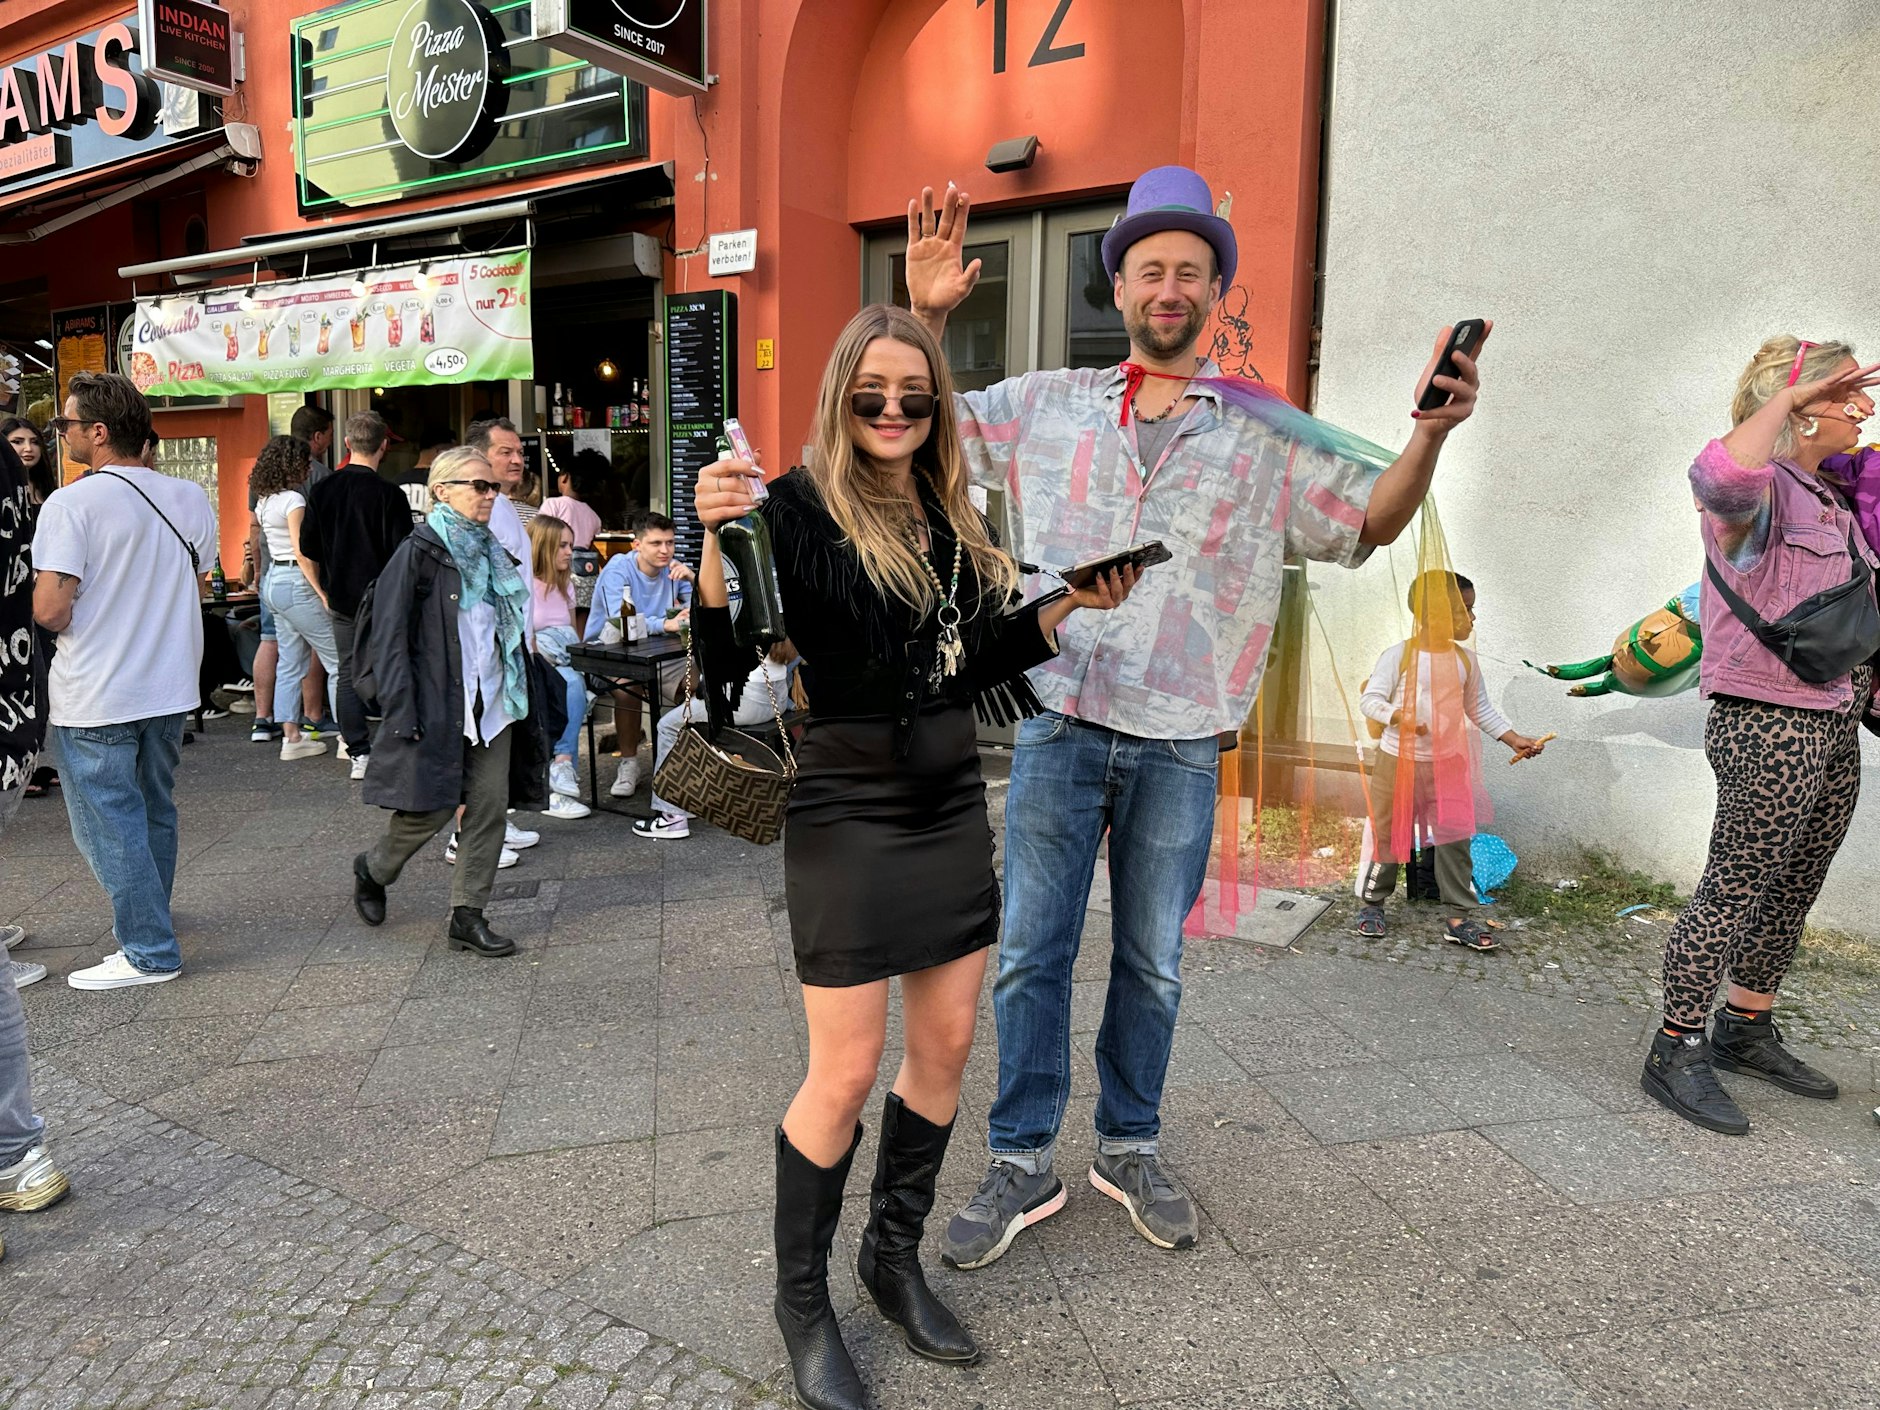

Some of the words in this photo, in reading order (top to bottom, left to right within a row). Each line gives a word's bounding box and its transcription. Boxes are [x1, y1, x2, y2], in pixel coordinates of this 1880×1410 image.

[159, 5, 225, 41] INDIAN
[160, 24, 182, 38] LIVE
[184, 31, 226, 51] KITCHEN
[408, 21, 465, 68] Pizza
[613, 23, 644, 48] SINCE
[645, 36, 666, 56] 2017
[174, 55, 197, 69] SINCE
[198, 61, 215, 74] 2000
[396, 65, 484, 119] Meister
[718, 239, 747, 251] Parken
[712, 253, 752, 266] verboten!
[469, 264, 479, 280] 5
[476, 298, 496, 311] nur
[496, 287, 517, 309] 25
[65, 316, 96, 332] ABIRAMS
[168, 359, 205, 383] Pizza
[263, 369, 284, 380] PIZZA
[285, 367, 310, 379] FUNGI
[322, 362, 375, 377] MARGHERITA
[384, 360, 417, 373] VEGETA
[227, 370, 255, 382] SALAMI
